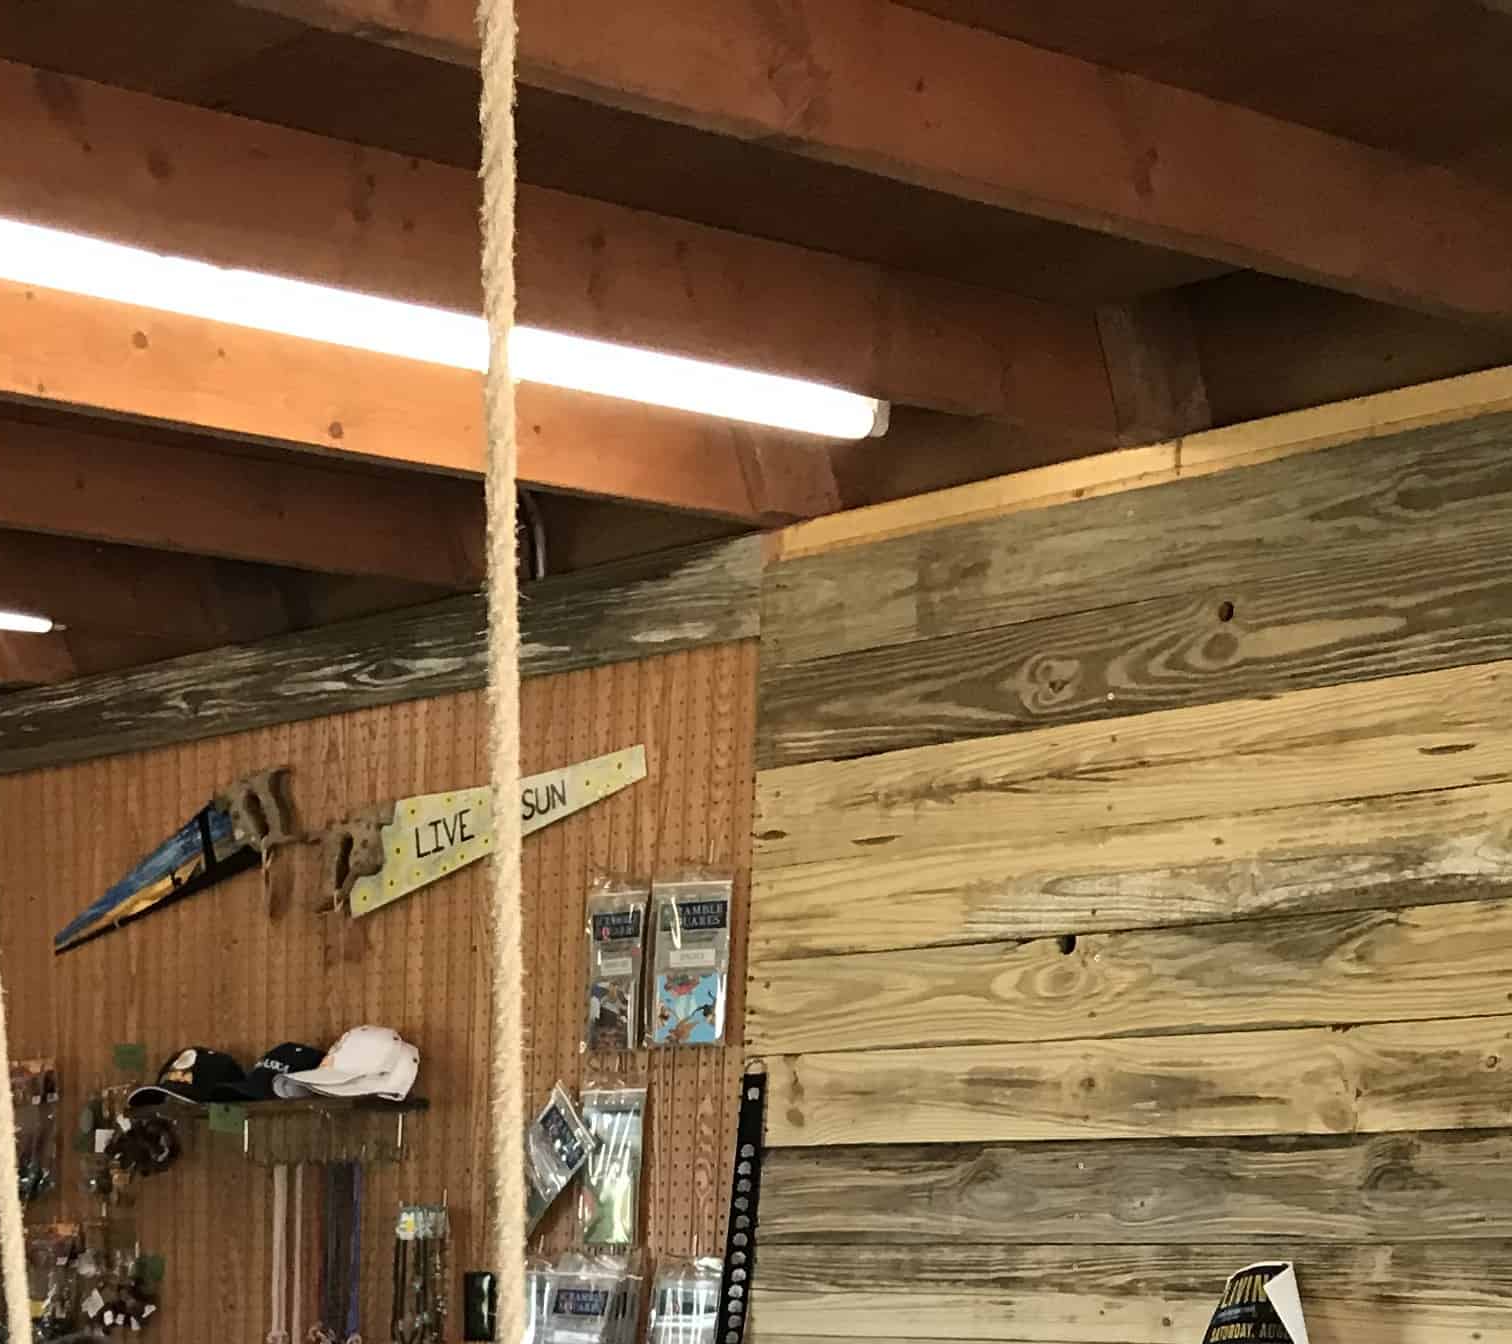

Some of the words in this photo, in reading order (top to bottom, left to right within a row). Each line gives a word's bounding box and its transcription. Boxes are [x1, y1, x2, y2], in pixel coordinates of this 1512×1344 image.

[521, 780, 567, 820] SUN
[415, 809, 475, 858] LIVE
[1219, 1274, 1269, 1309] LIVIN
